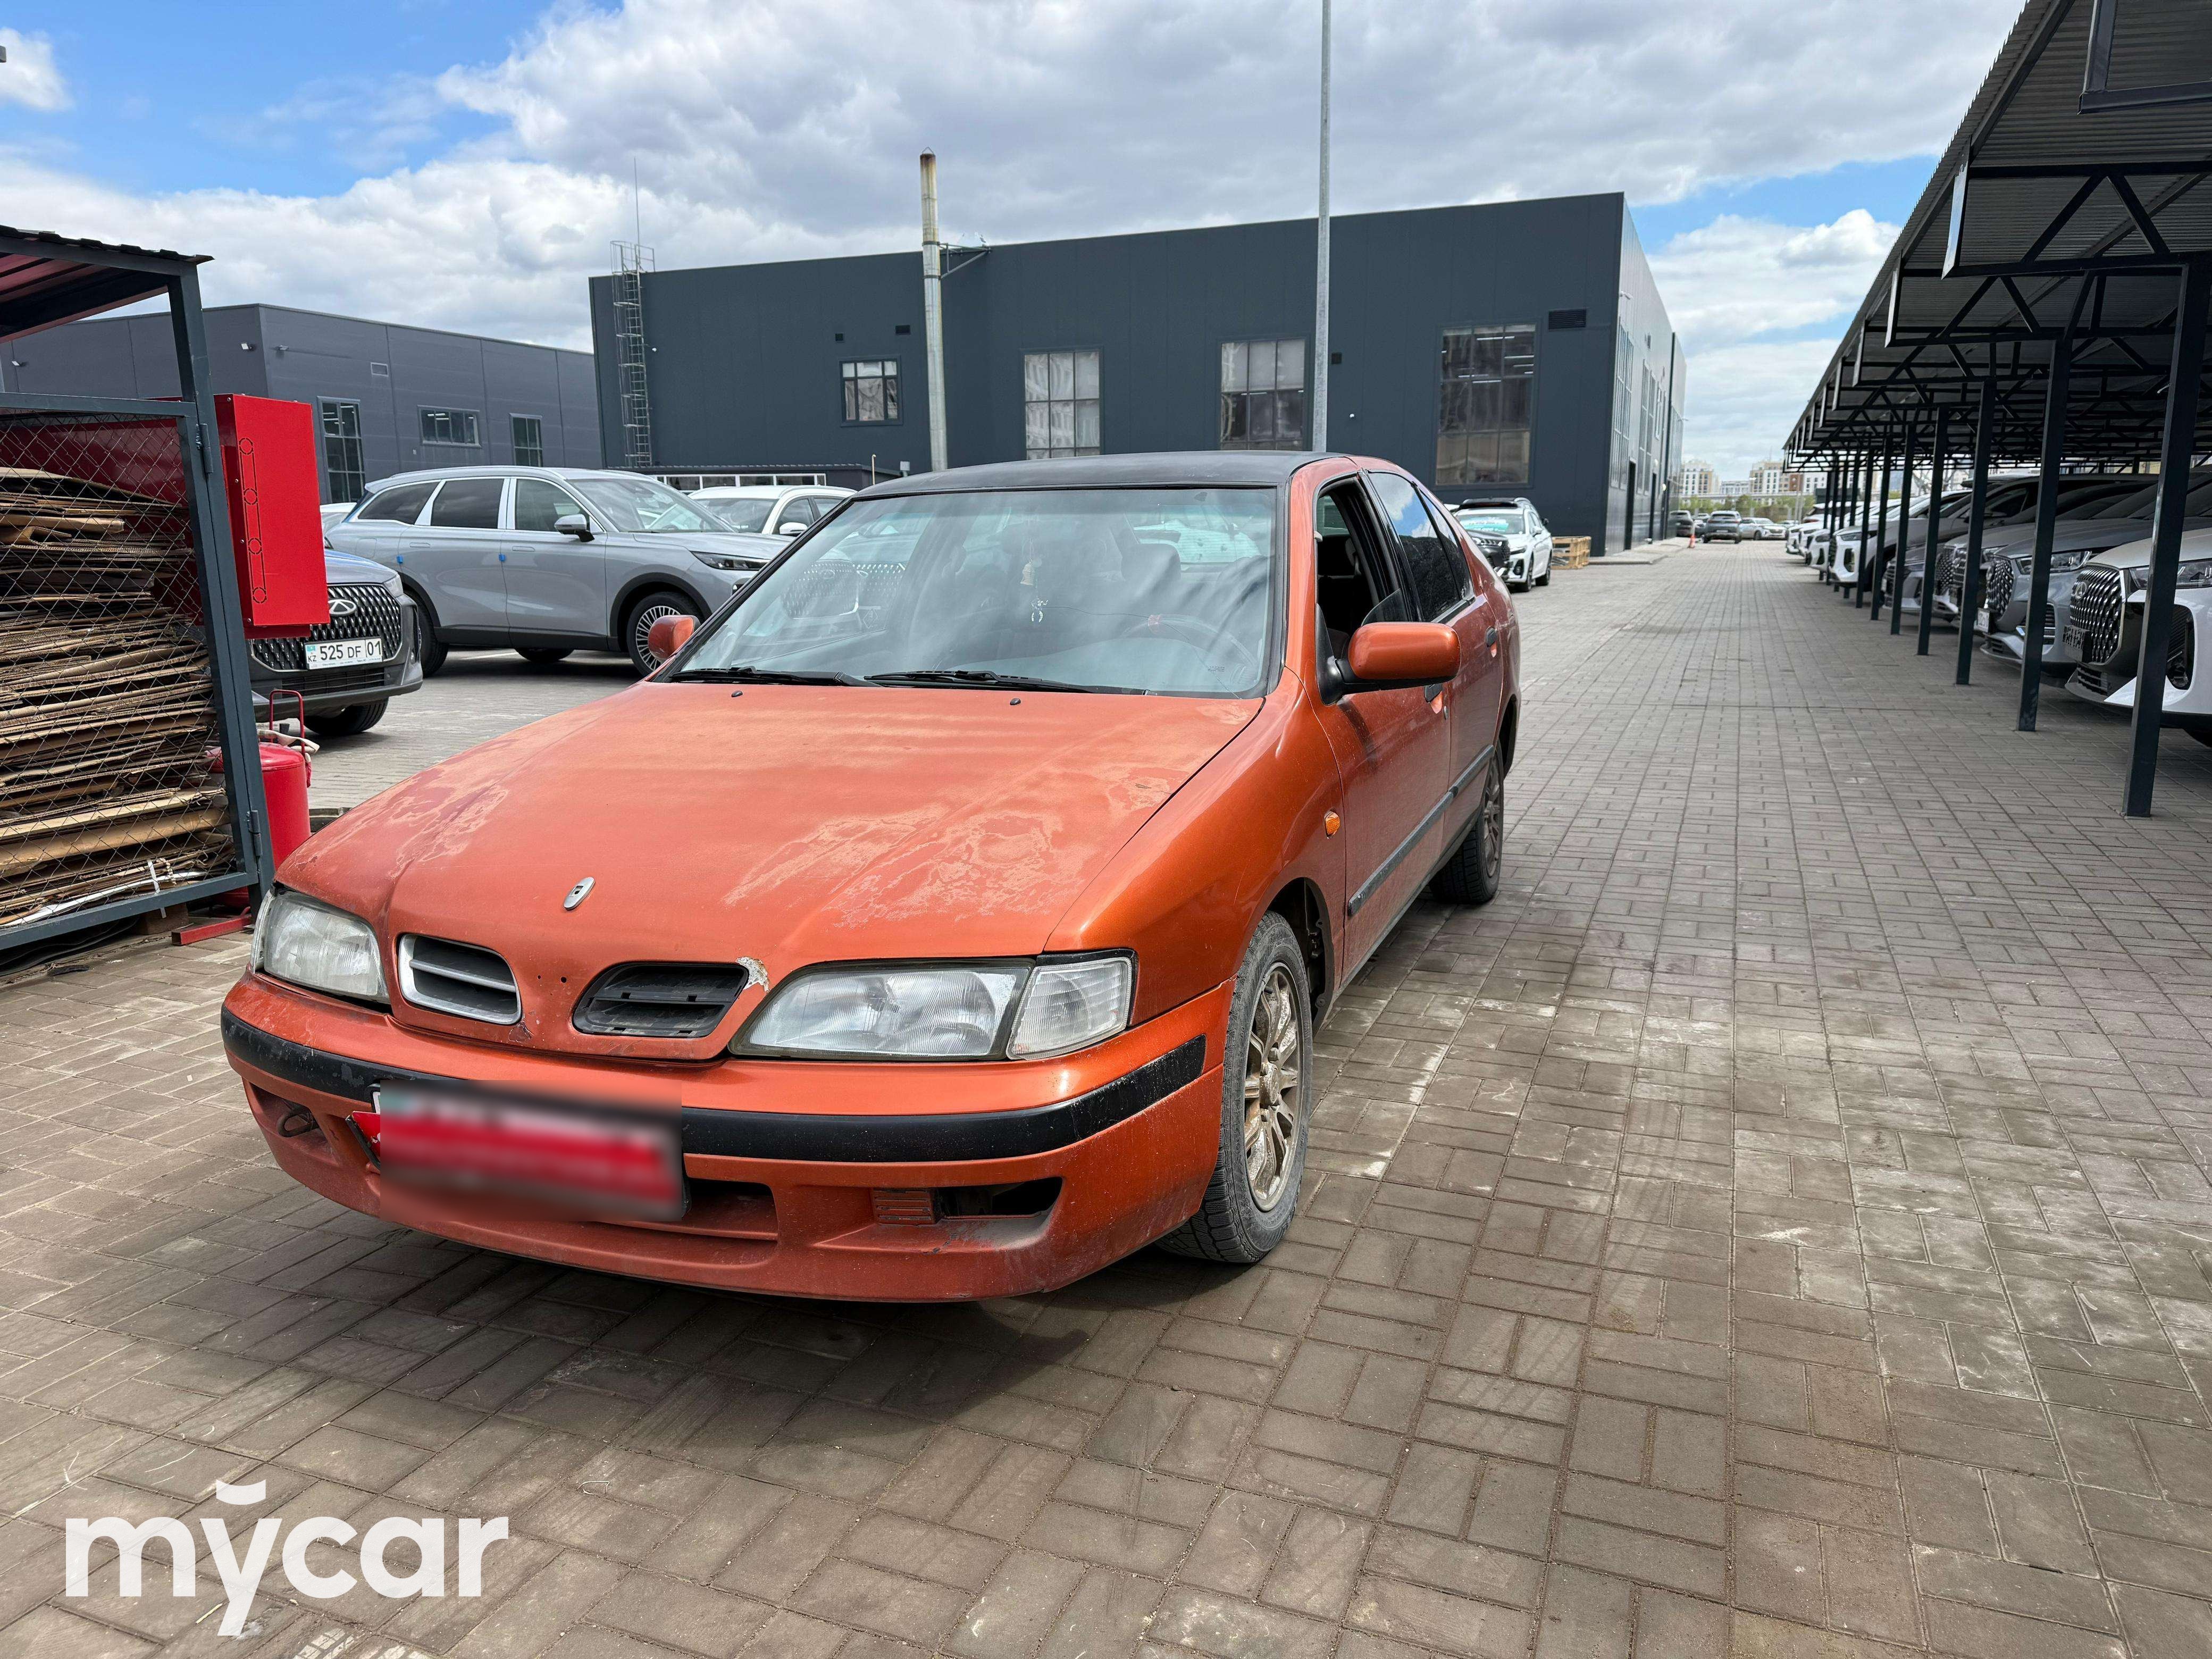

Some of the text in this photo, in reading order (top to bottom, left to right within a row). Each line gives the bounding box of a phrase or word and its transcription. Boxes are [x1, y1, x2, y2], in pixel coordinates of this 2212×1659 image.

[320, 641, 381, 660] 525 DF 01
